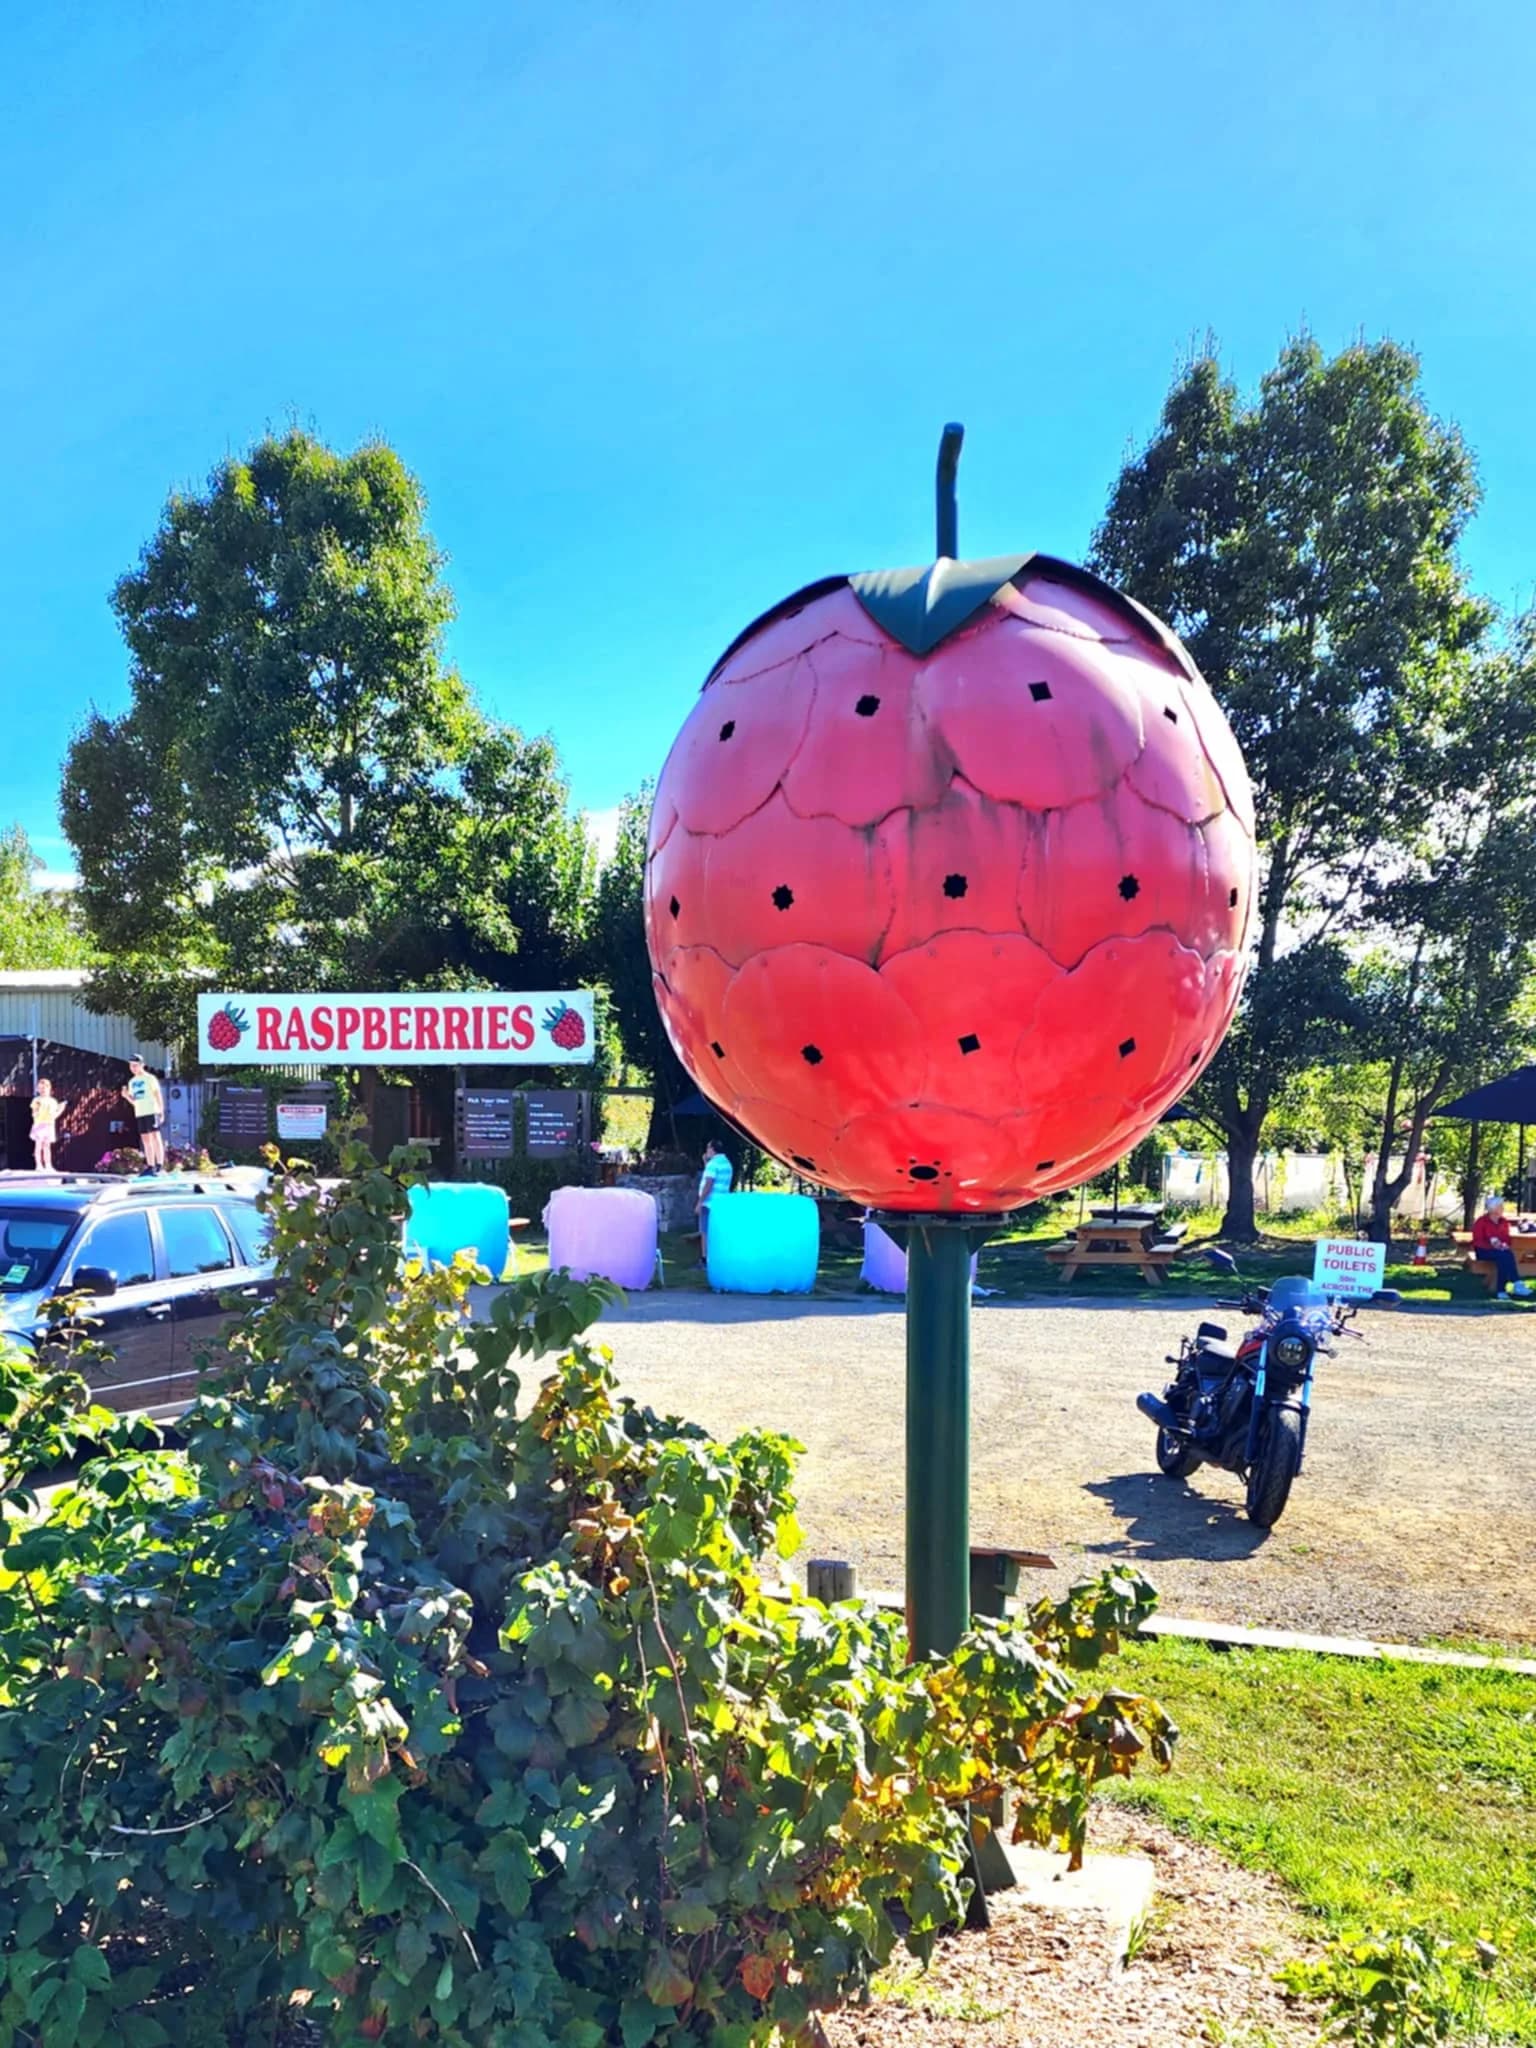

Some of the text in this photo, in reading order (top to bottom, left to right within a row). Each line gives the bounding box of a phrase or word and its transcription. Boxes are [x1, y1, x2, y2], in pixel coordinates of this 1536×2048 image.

[256, 1005, 535, 1051] RASPBERRIES
[1327, 1244, 1375, 1257] PUBLIC
[1323, 1258, 1376, 1272] TOILETS
[1321, 1283, 1355, 1292] ACROSS
